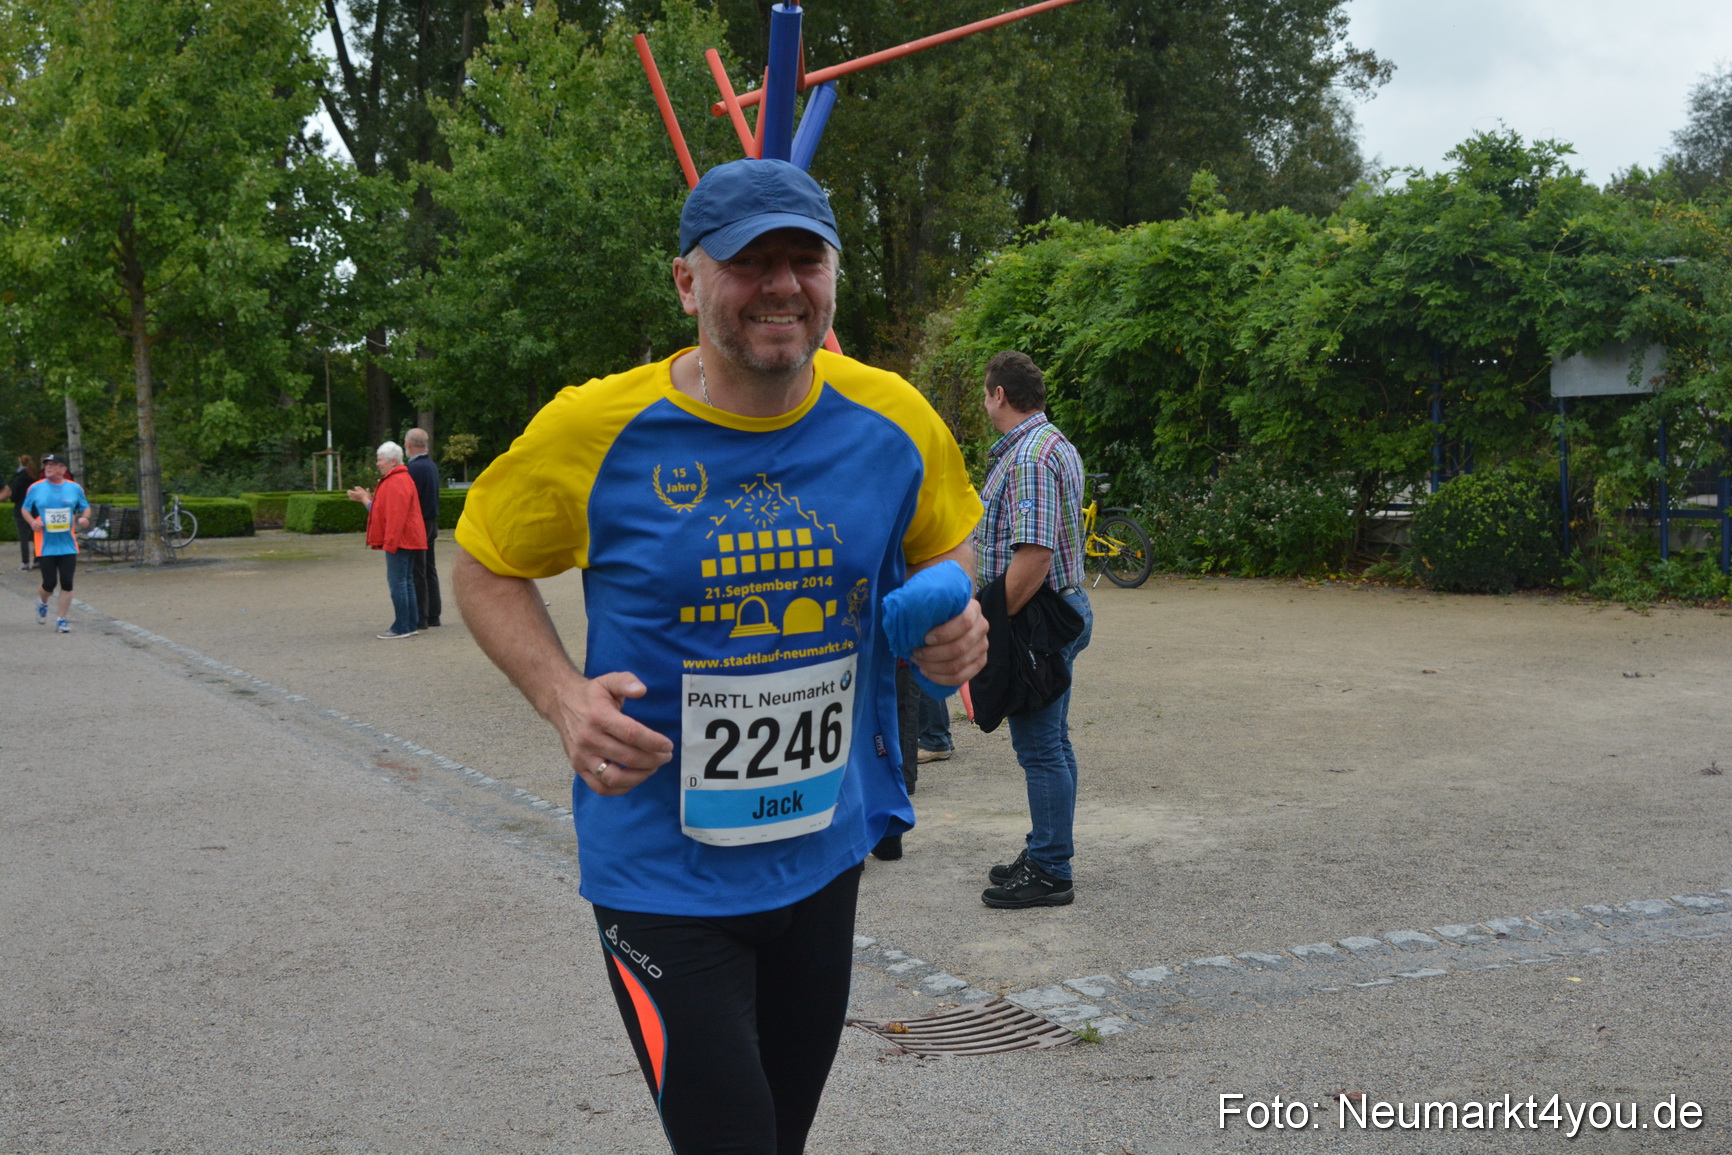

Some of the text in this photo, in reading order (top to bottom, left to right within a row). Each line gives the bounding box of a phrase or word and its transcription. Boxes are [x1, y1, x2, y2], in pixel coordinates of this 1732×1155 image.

[673, 468, 687, 478] 15
[666, 482, 697, 493] Jahre
[50, 514, 67, 523] 325
[705, 576, 833, 599] 21.September 2014
[683, 640, 854, 668] www.stadtlauf-neumarkt.de
[687, 680, 835, 709] PARTL Neumarkt
[703, 702, 843, 780] 2246
[689, 776, 698, 788] D
[752, 790, 804, 819] Jack
